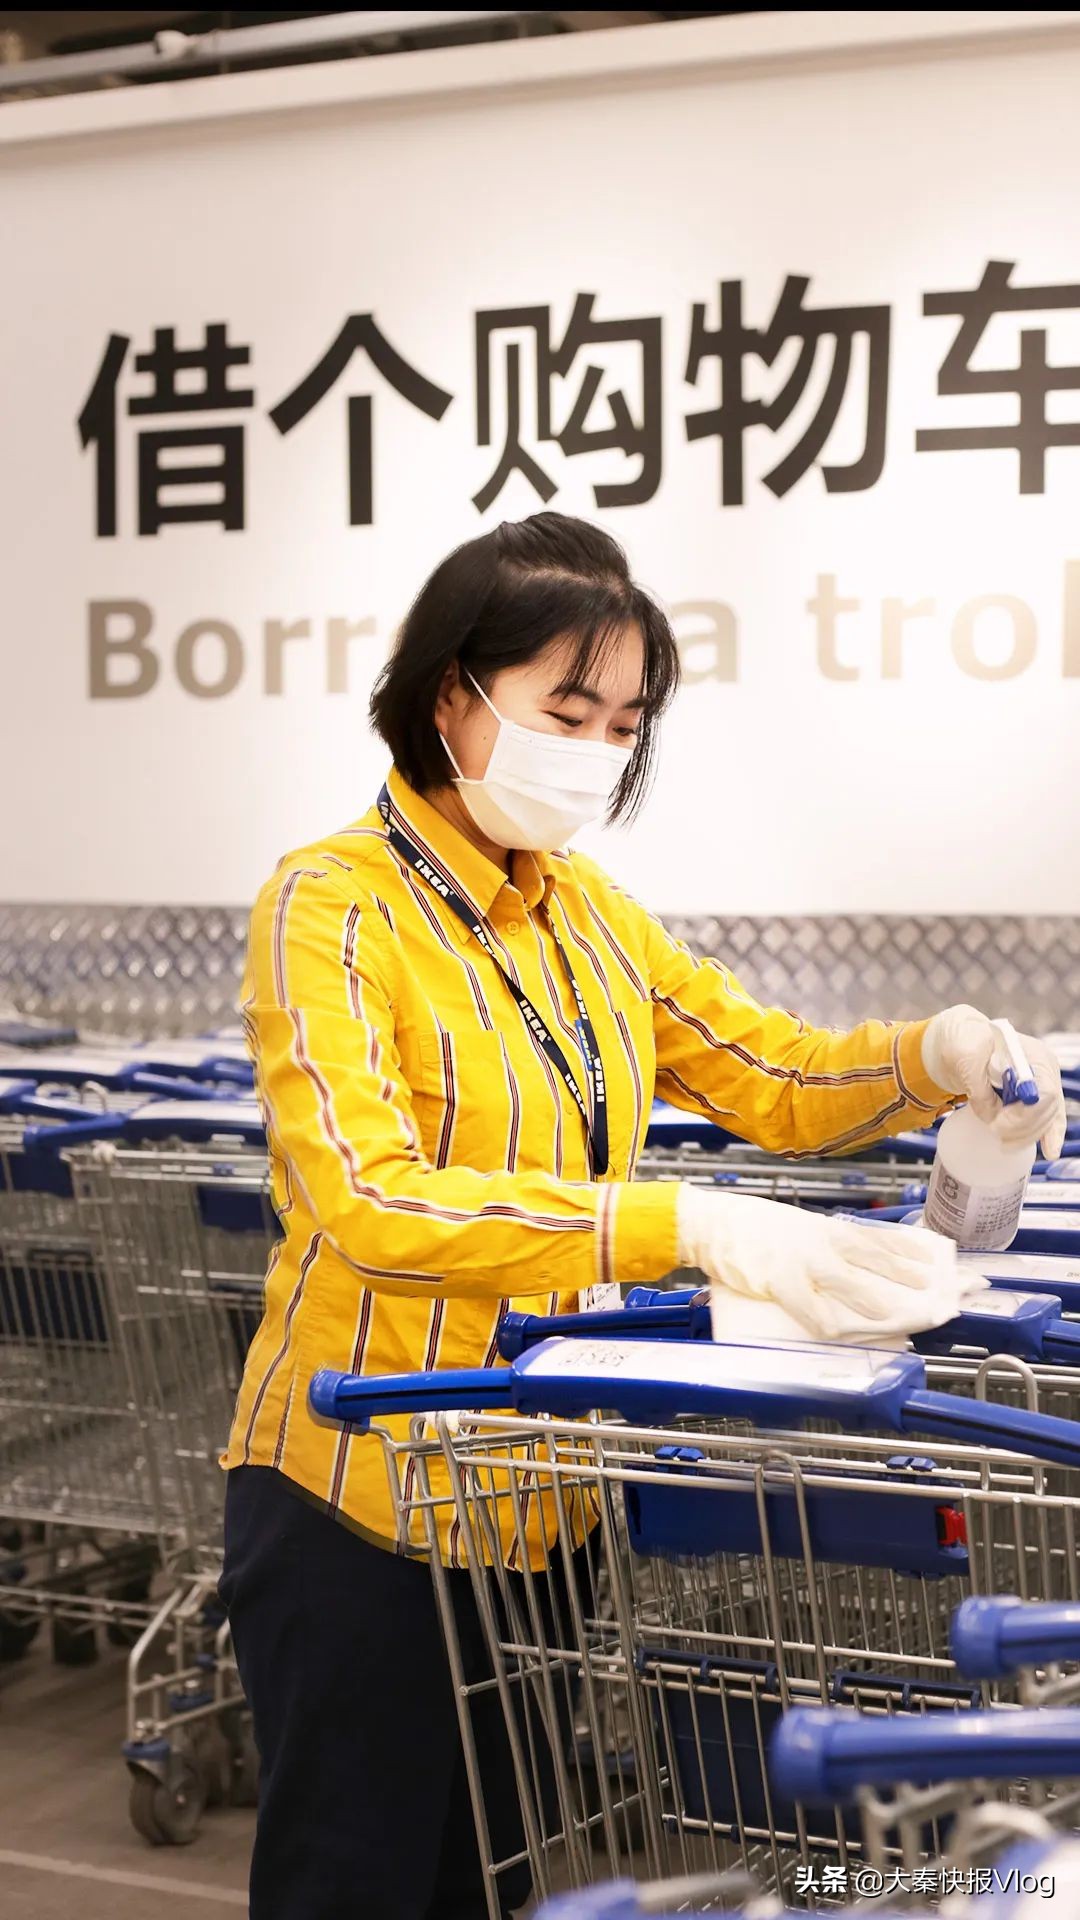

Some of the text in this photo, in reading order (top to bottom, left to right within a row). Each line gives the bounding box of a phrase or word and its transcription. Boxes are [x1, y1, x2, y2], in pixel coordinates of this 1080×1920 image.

[77, 260, 1080, 537] 借个购物车
[88, 599, 402, 700] Borr
[414, 858, 451, 898] IKEA
[519, 999, 549, 1043] IKEA
[593, 1056, 606, 1103] IKEA
